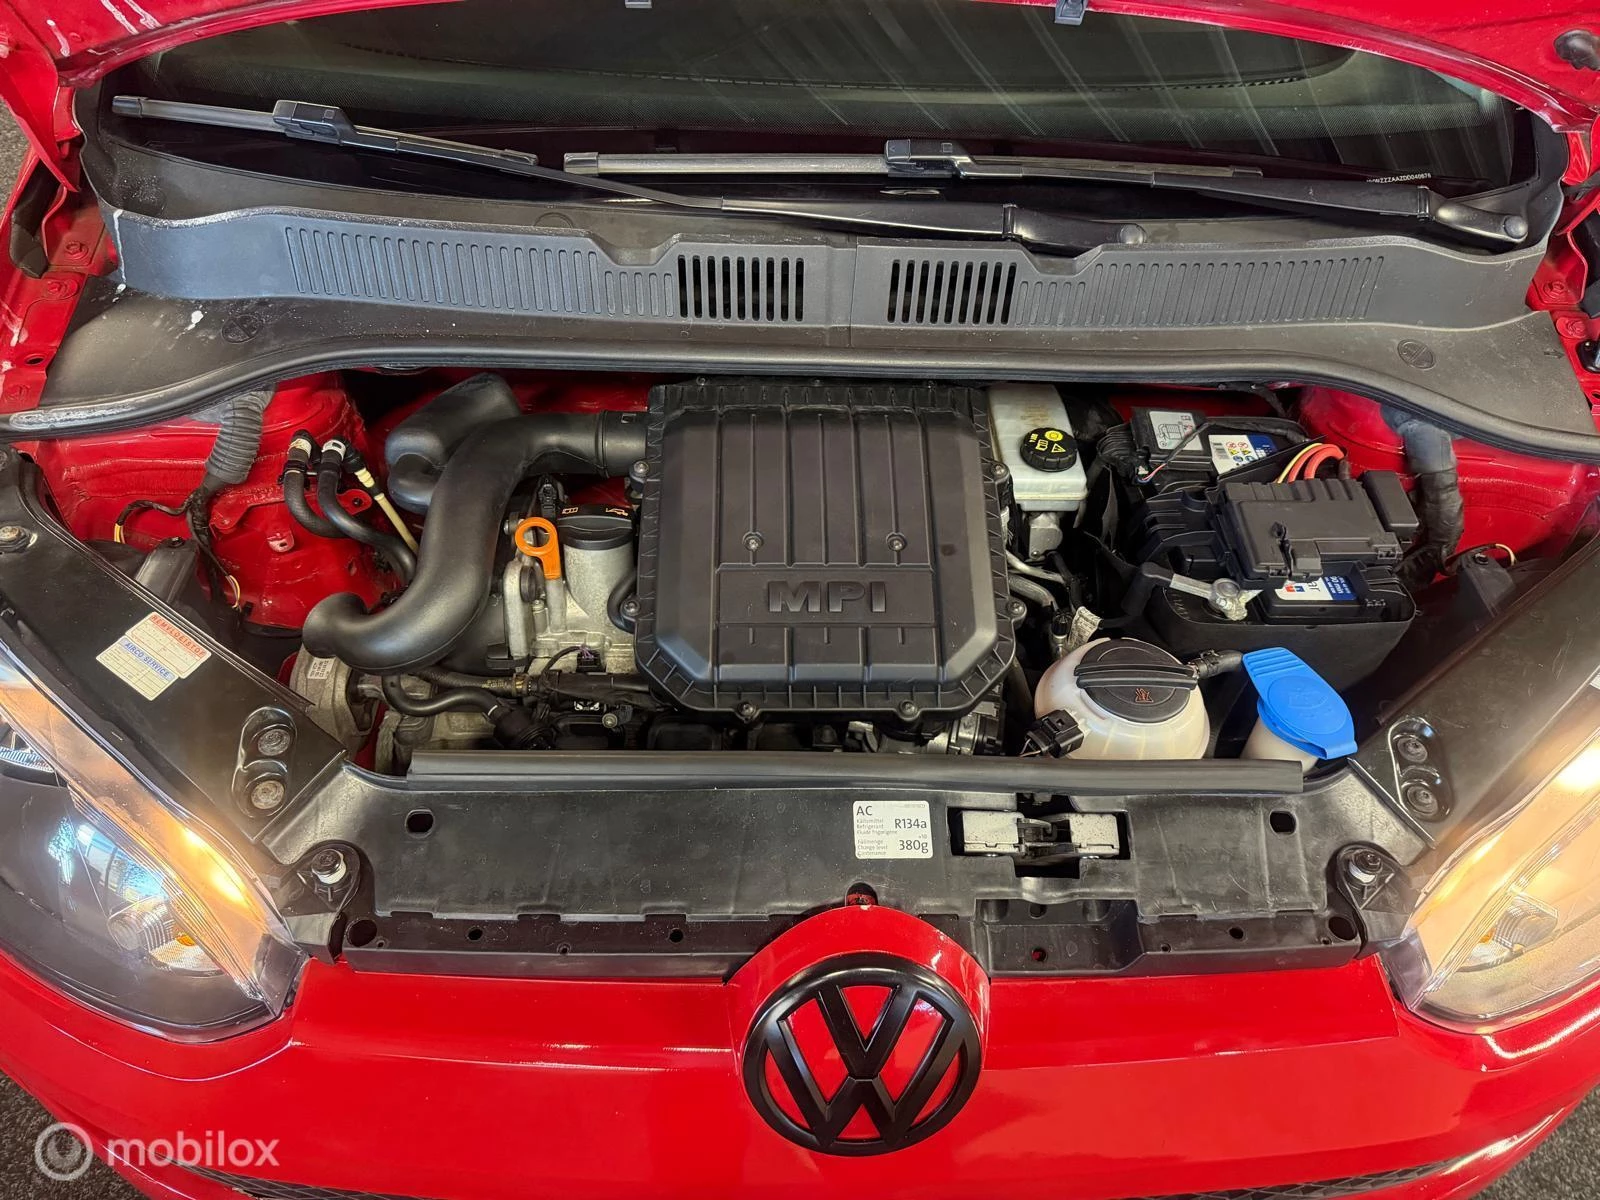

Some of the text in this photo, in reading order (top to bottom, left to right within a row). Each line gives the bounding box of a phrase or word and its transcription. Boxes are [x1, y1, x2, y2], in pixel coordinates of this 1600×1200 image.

[768, 580, 887, 613] MPI
[124, 642, 146, 659] AIRCO
[143, 655, 170, 678] SERVICE
[856, 805, 873, 816] AC
[894, 818, 927, 829] R134a
[898, 839, 929, 854] 380g
